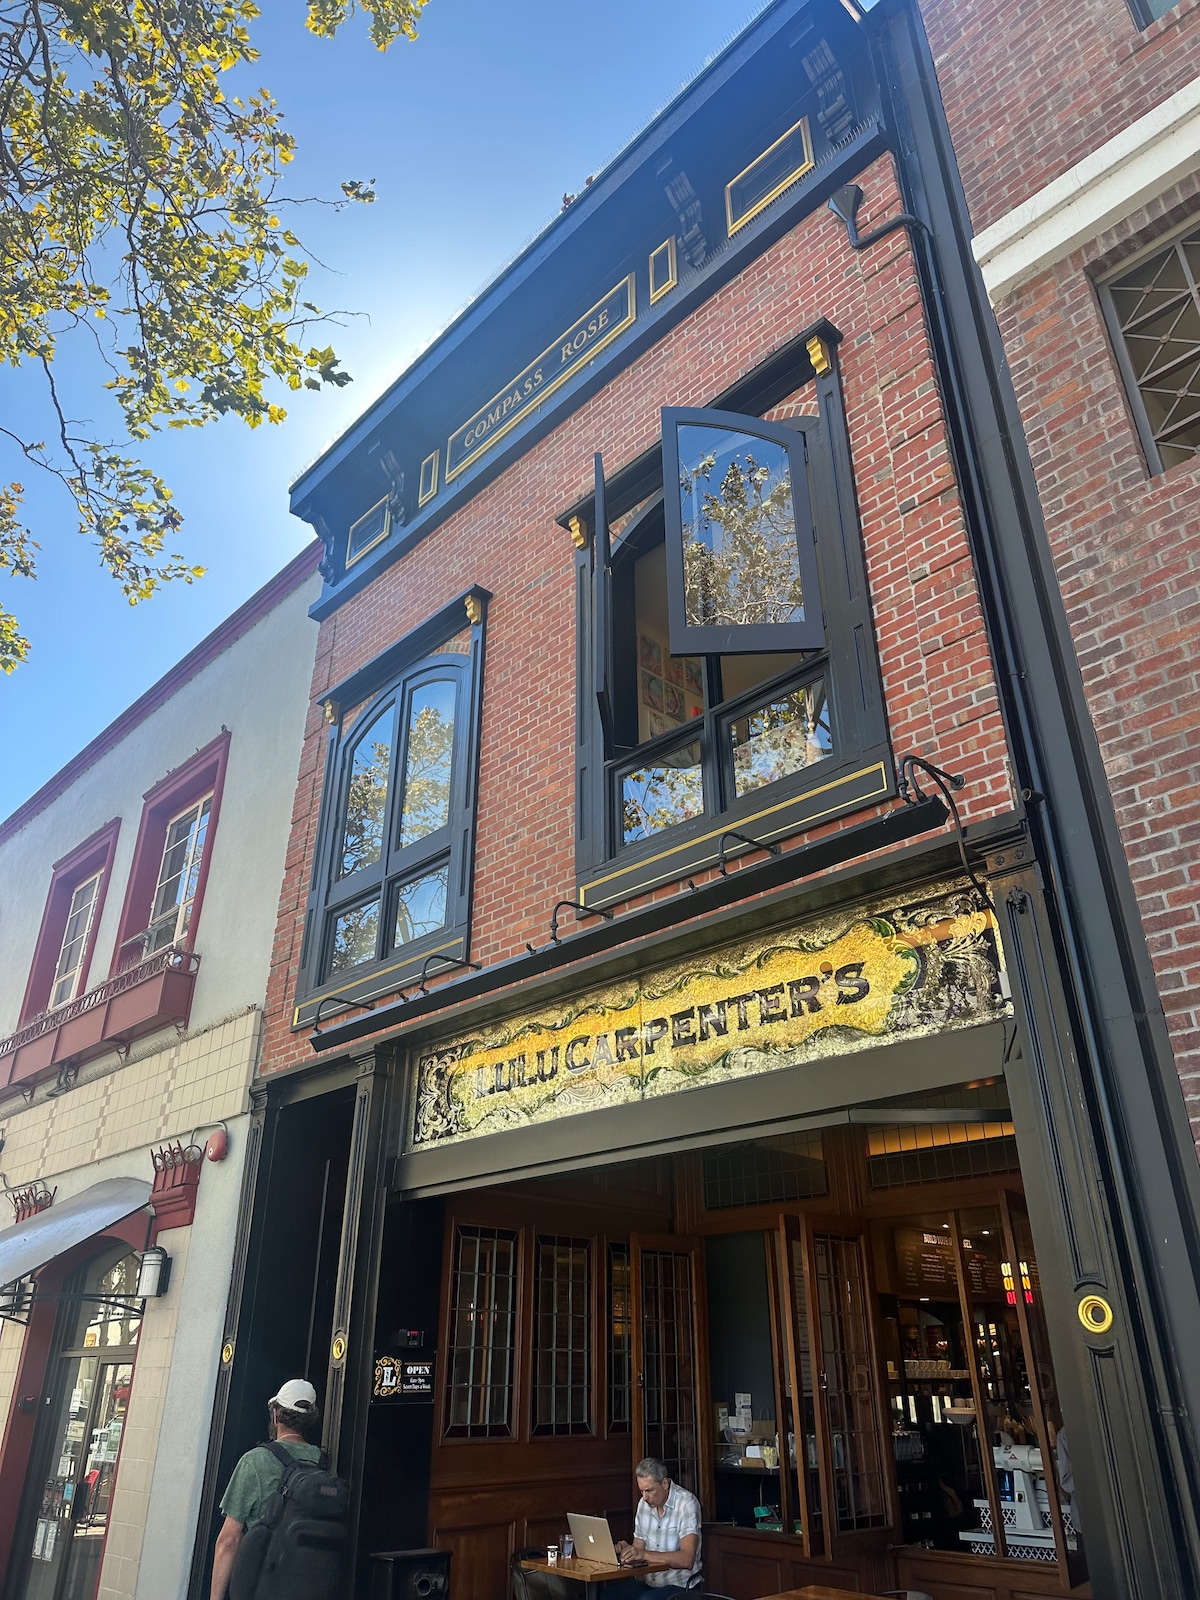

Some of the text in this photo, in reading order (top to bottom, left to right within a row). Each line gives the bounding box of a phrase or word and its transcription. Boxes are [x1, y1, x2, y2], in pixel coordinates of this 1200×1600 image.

[463, 309, 610, 448] COMPASS ROSE
[474, 961, 871, 1100] LULU CARPENTER'S
[382, 1366, 397, 1387] L
[407, 1366, 430, 1374] OPEN
